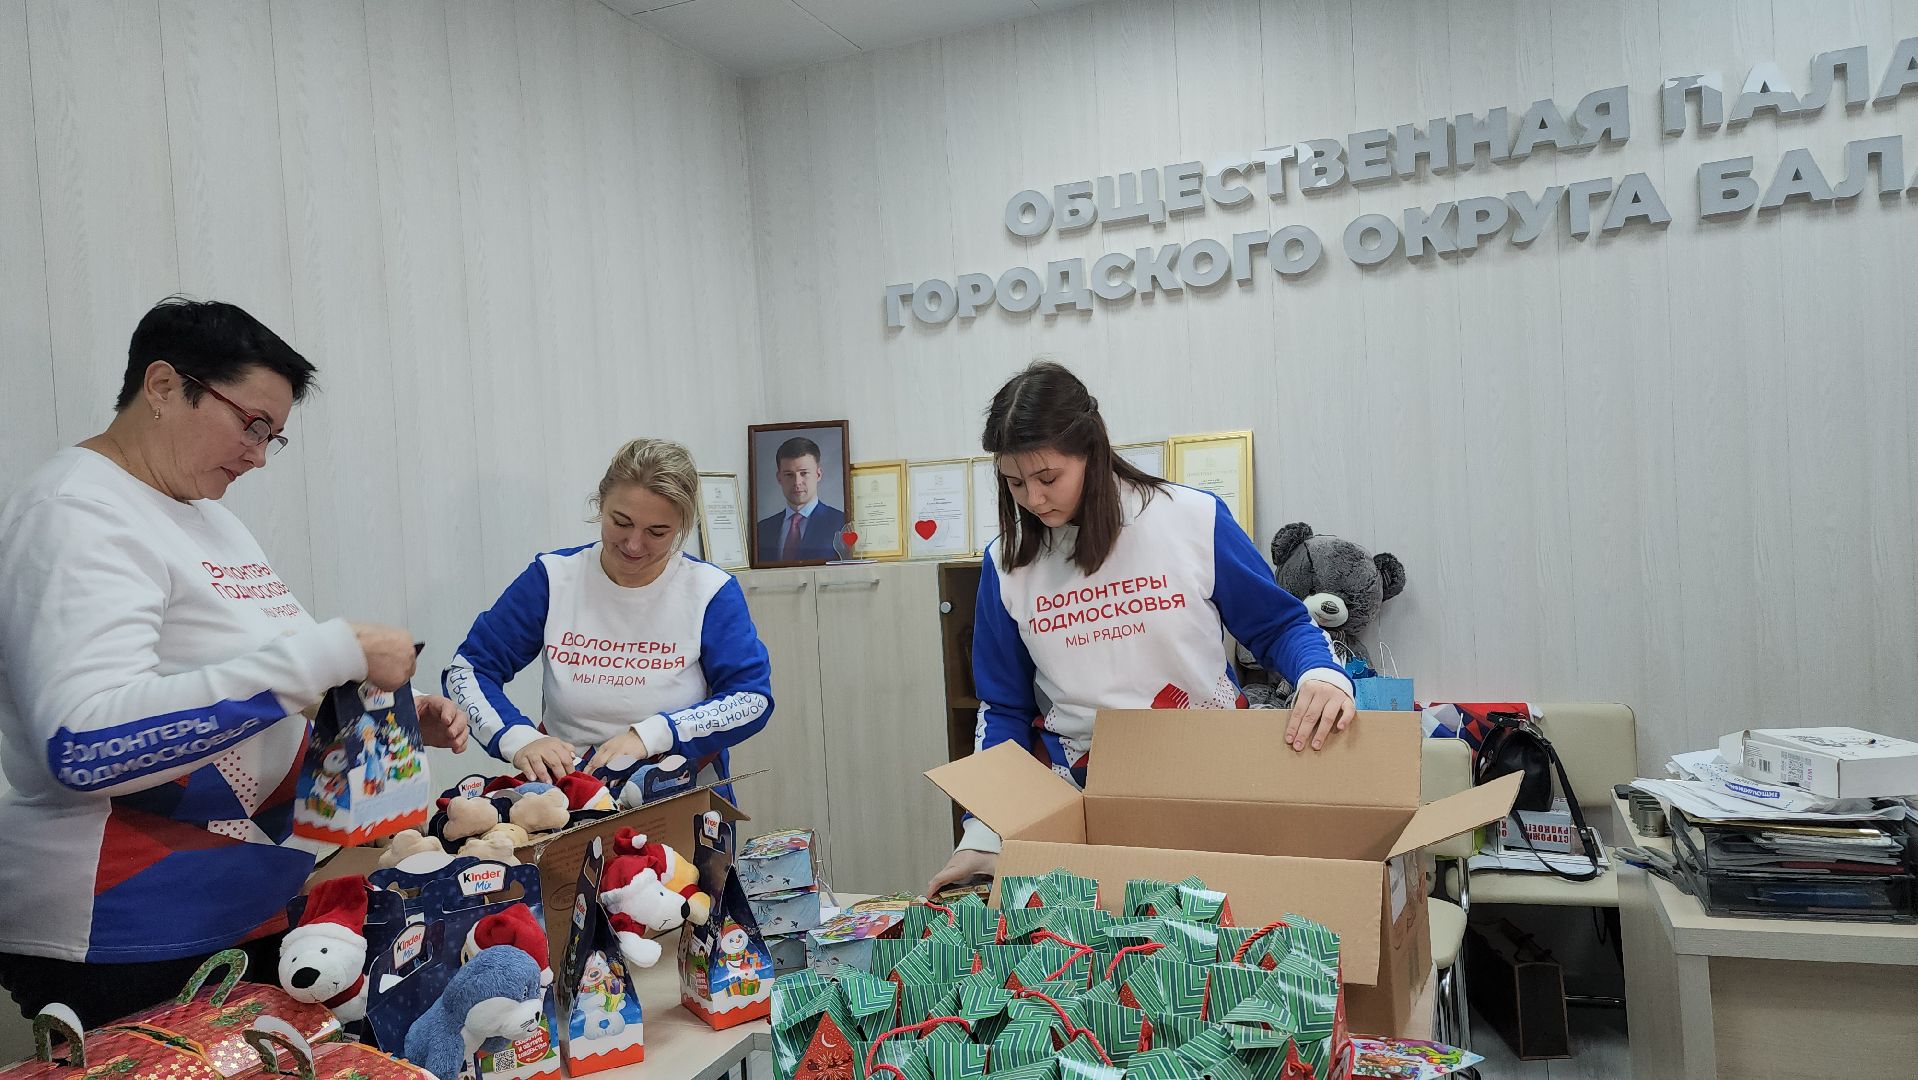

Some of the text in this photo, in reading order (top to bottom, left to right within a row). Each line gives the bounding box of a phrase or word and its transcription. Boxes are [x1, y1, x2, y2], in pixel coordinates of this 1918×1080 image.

[1005, 85, 1630, 237] ОБЩЕСТВЕННАЯ
[886, 135, 1918, 328] ГОРОДСКОГО ОКРУГА БАЛ
[202, 561, 272, 580] ВЛОНТЕРЫ
[1036, 575, 1168, 612] ВОЛОНТЕРЫ
[1029, 593, 1186, 636] ПОДМОСКОВЬЯ
[561, 631, 676, 654] ВОЛОНТЕРЫ
[1065, 622, 1146, 648] МЫ РЯДОМ
[546, 644, 685, 670] ПОДМОСКОВЬЯ
[572, 672, 646, 687] МЫ РЯДОМ
[474, 879, 492, 892] Mix
